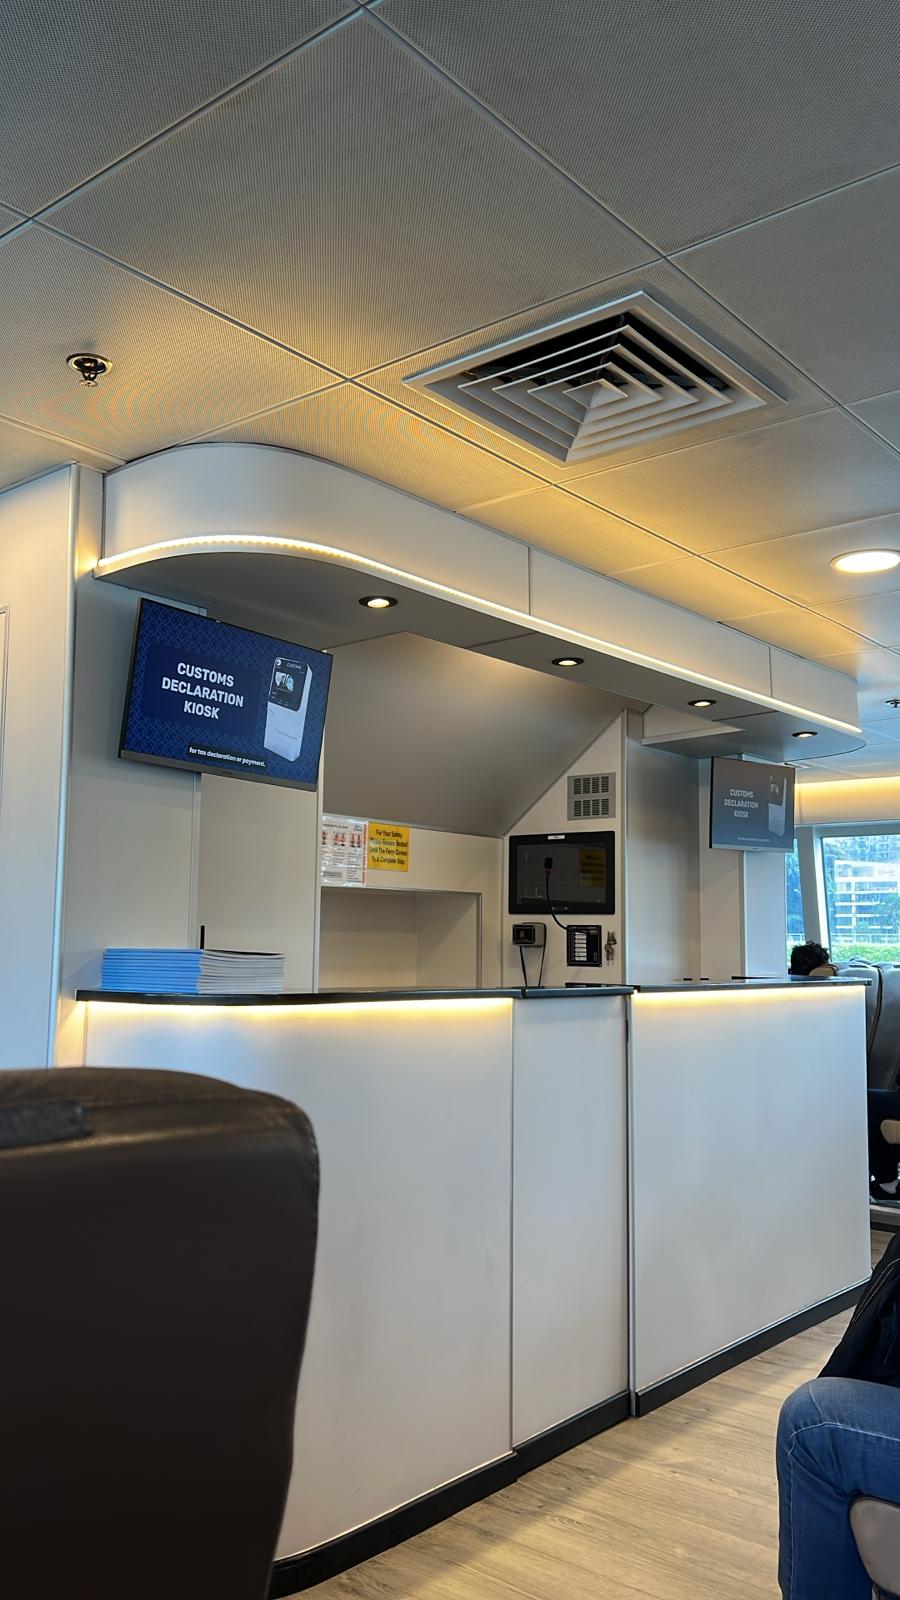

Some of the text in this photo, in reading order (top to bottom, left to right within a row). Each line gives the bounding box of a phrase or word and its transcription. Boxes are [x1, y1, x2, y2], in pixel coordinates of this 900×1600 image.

[177, 662, 235, 687] CUSTOMS
[161, 677, 244, 707] DECLARATION
[183, 700, 220, 720] KIOSK
[189, 746, 198, 754] for
[206, 750, 236, 762] declaration
[242, 758, 266, 768] payment.
[724, 798, 759, 809] DECLARATION
[729, 788, 754, 799] CUSTOMS
[734, 810, 749, 818] KIOSK
